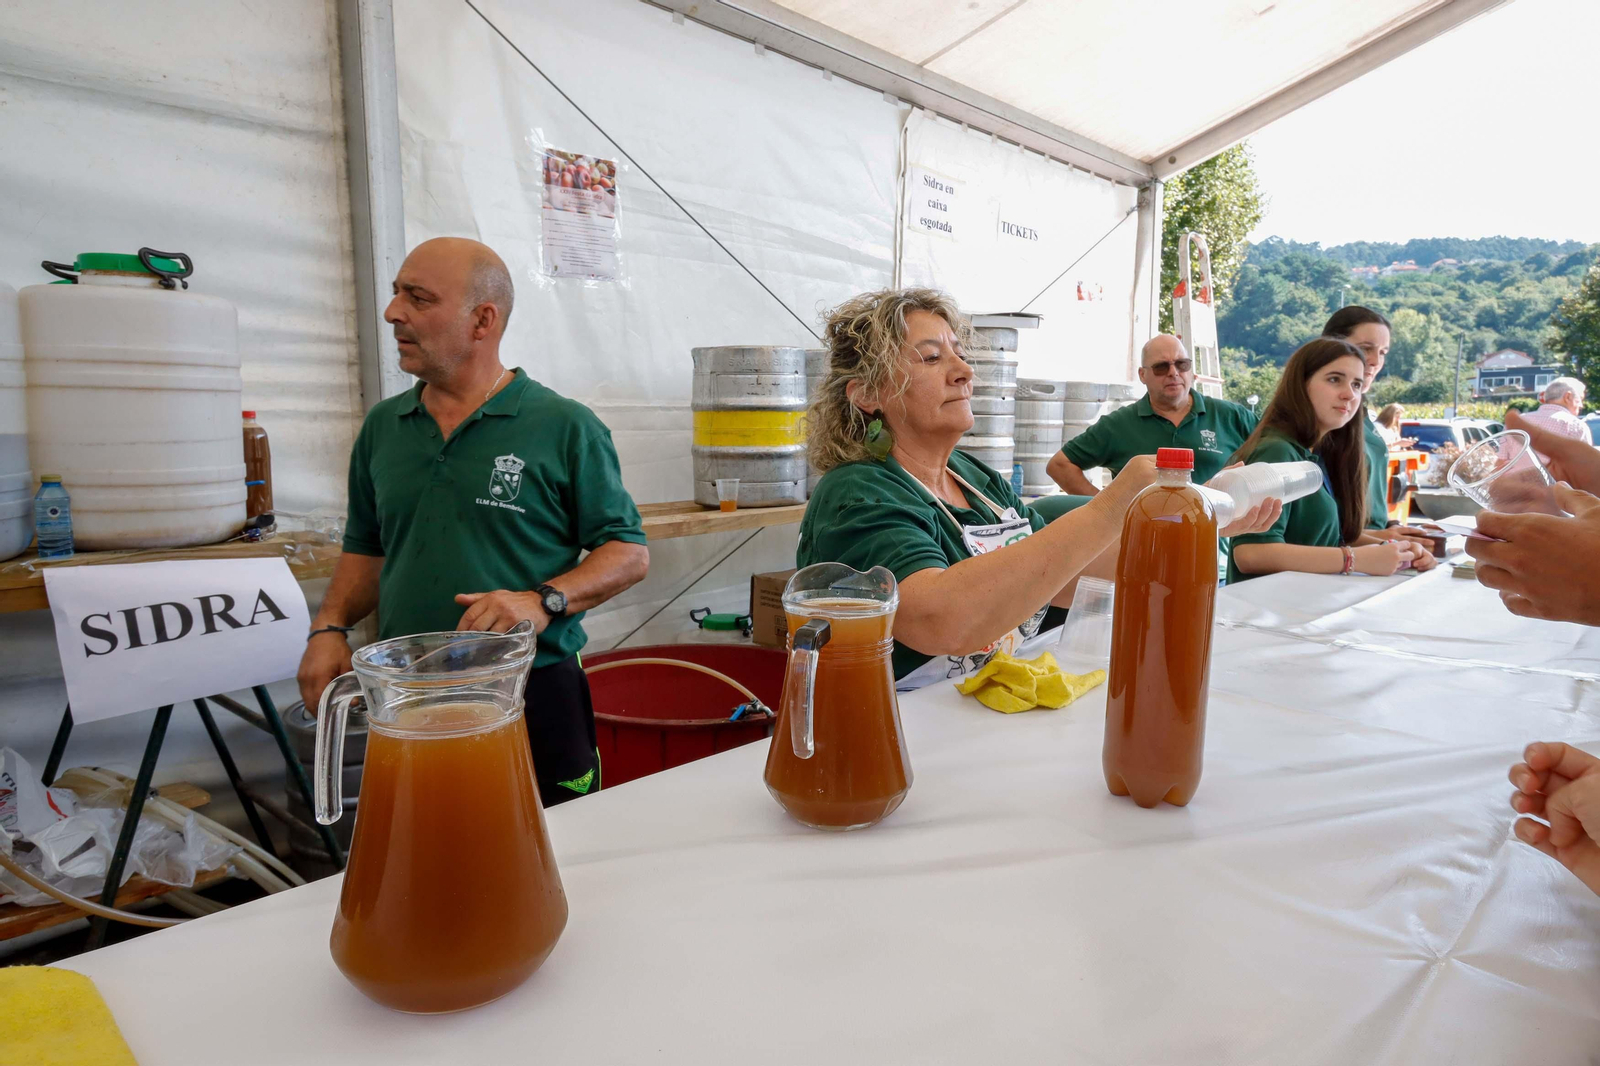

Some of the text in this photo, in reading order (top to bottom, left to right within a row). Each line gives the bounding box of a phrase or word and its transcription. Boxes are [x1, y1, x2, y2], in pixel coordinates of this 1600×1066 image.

[923, 174, 954, 195] Sidra en
[927, 198, 948, 213] caixa
[920, 216, 953, 234] esgotada
[1001, 220, 1039, 242] TICKETS
[80, 587, 291, 658] SIDRA
